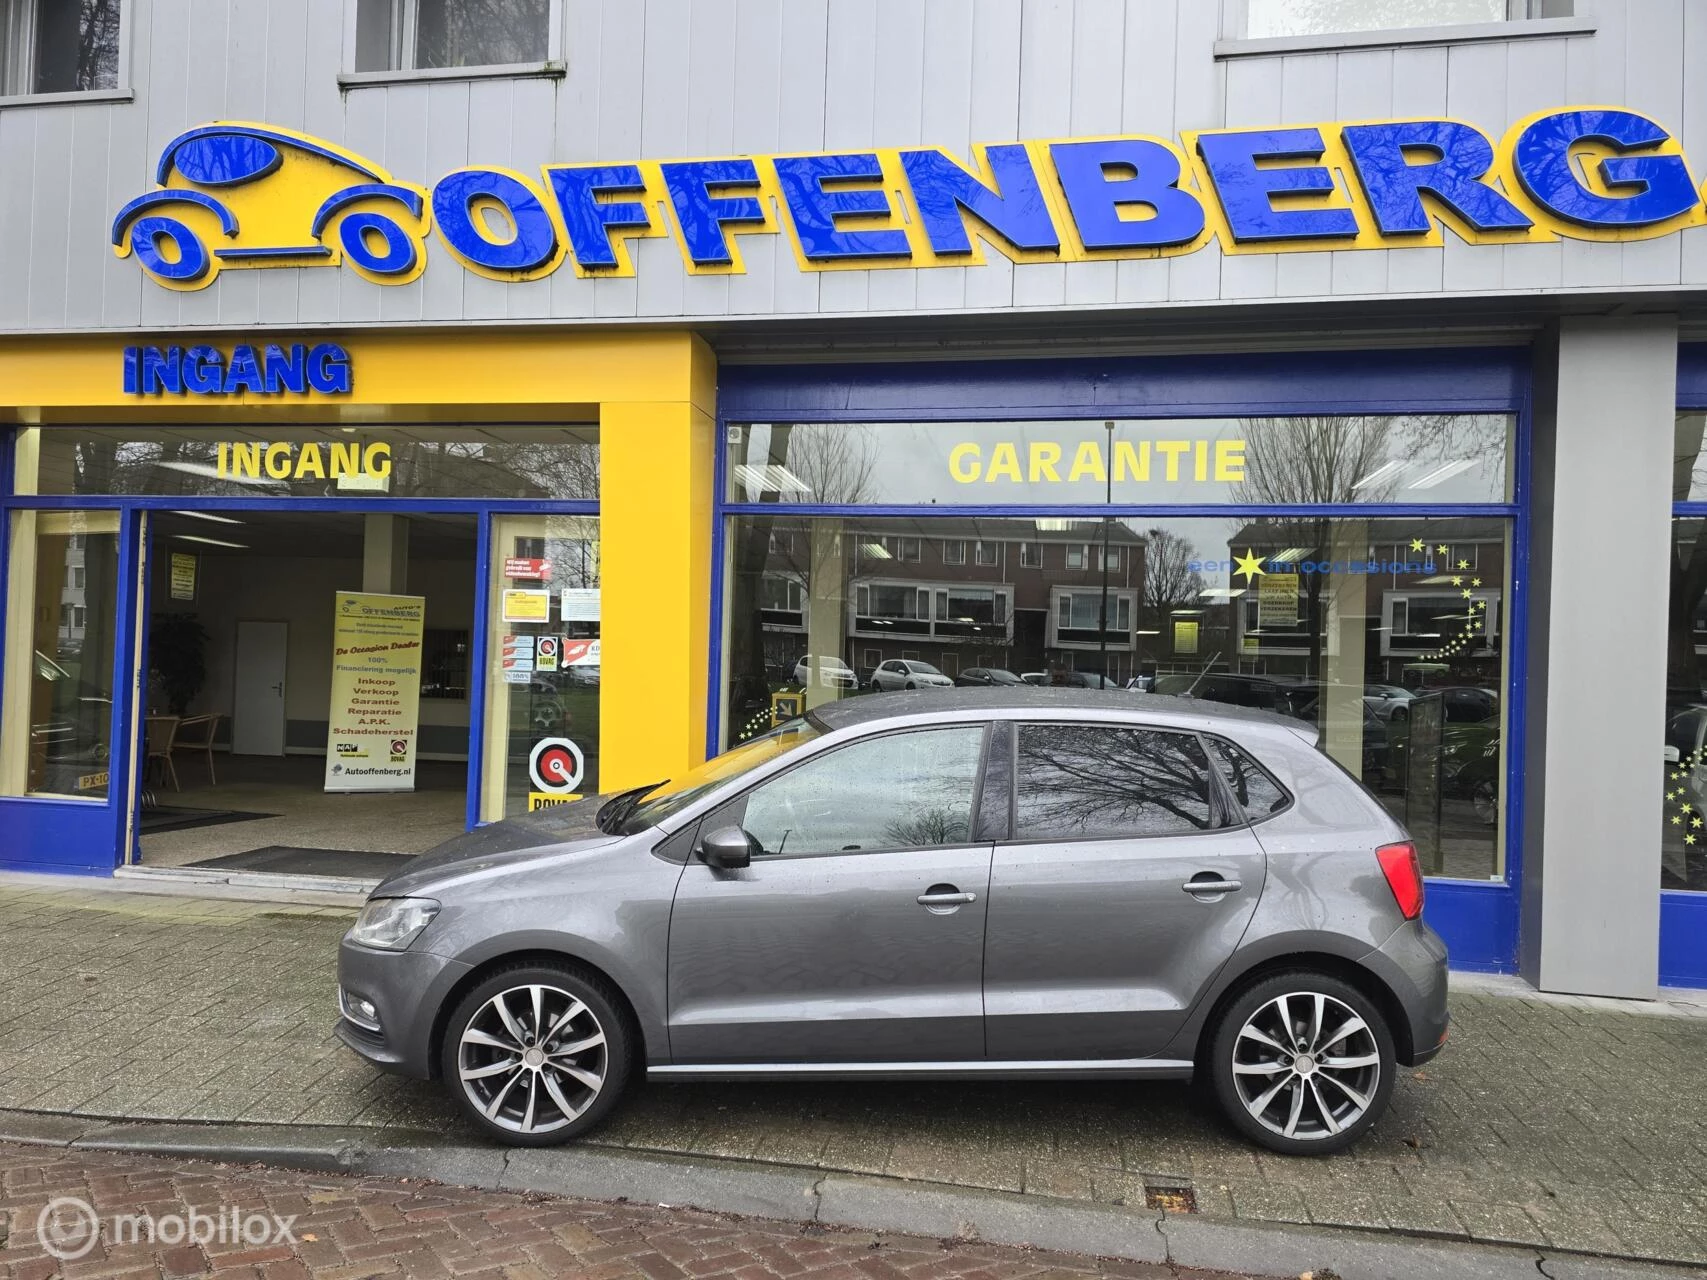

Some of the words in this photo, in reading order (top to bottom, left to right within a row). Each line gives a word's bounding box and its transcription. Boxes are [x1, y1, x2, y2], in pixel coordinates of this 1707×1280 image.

[432, 110, 1701, 271] OFFENBERG
[123, 343, 350, 394] INGANG
[217, 441, 392, 480] INGANG
[949, 440, 1246, 483] GARANTIE
[1187, 559, 1234, 573] een
[350, 644, 389, 654] Occasion
[336, 665, 383, 673] Financiering
[385, 667, 417, 675] mogelijk
[358, 678, 396, 686] Inkoop
[353, 688, 399, 696] Verkoop
[348, 708, 402, 716] Reparatie
[333, 728, 414, 736] Schadeherstel
[345, 768, 411, 777] Autooffenberg.nl
